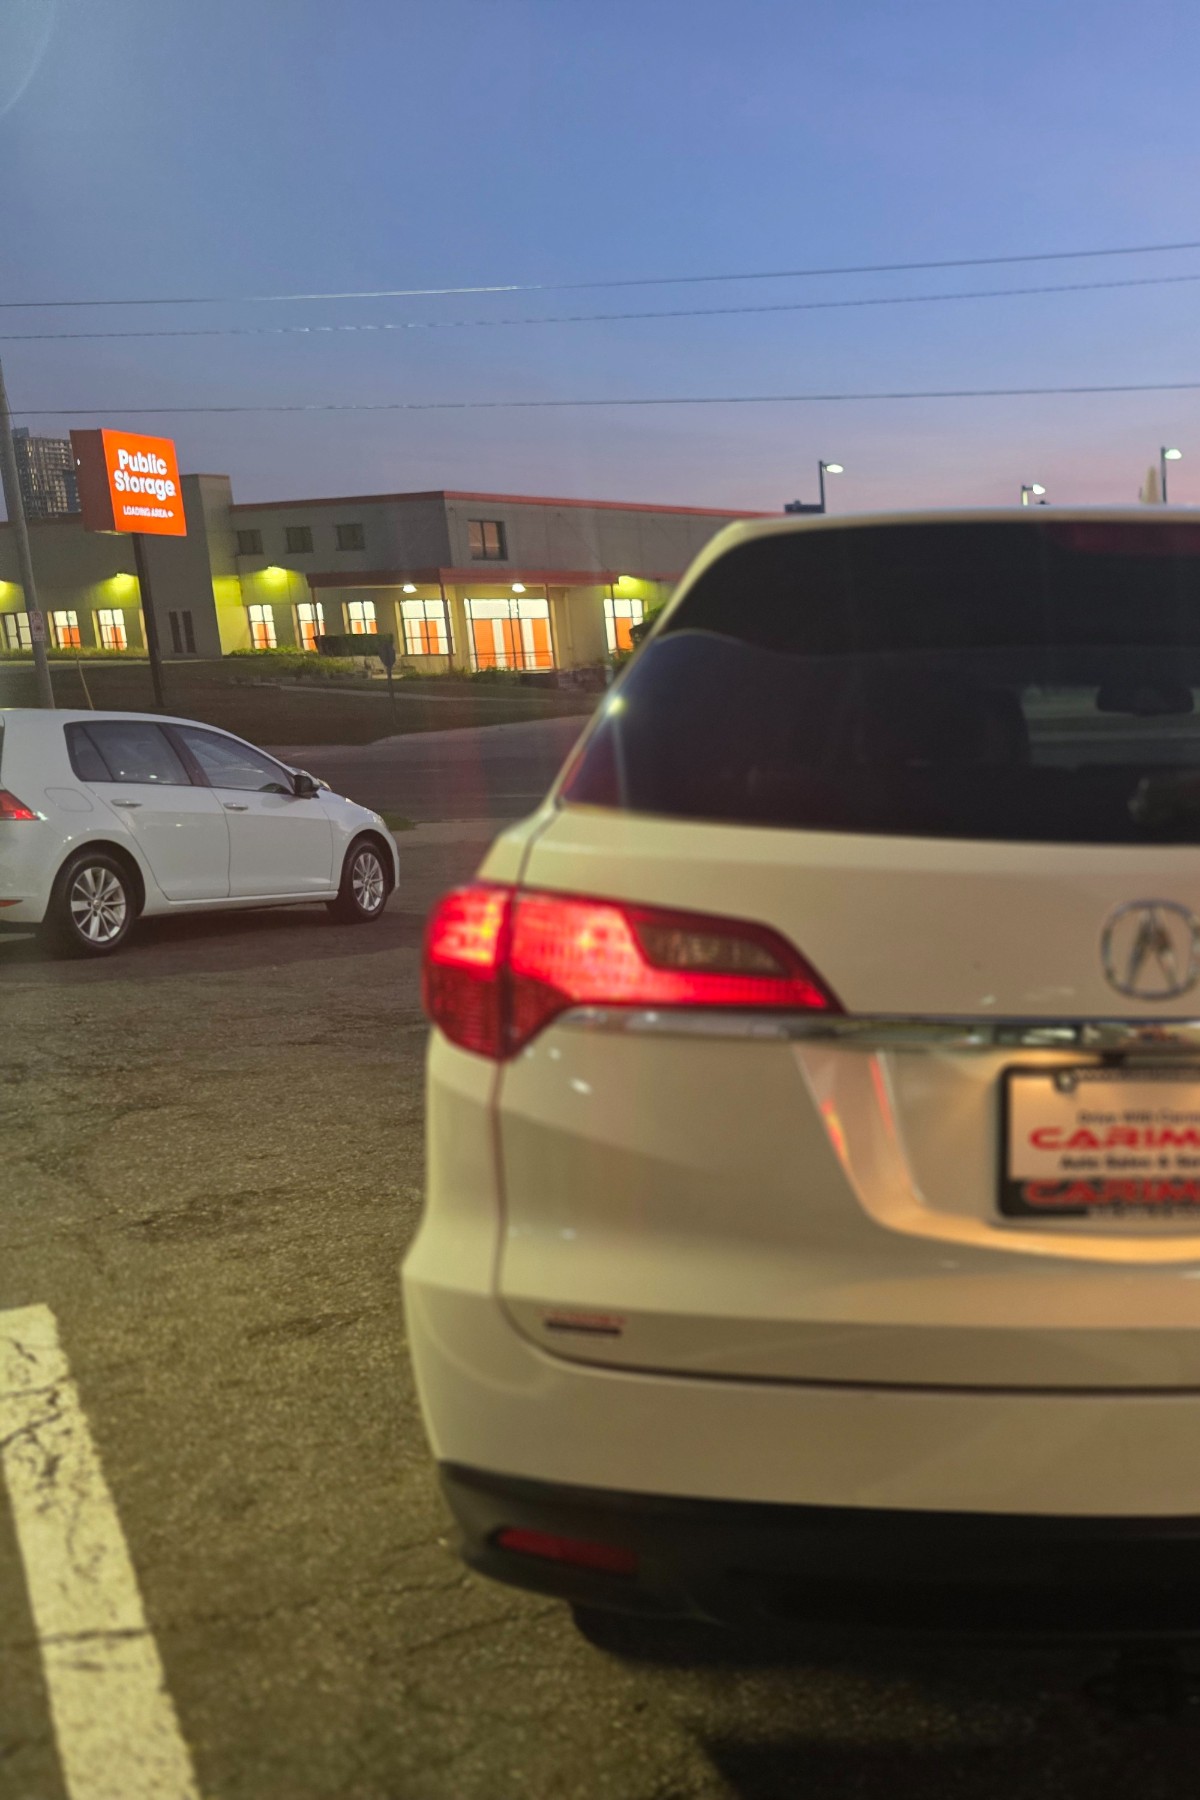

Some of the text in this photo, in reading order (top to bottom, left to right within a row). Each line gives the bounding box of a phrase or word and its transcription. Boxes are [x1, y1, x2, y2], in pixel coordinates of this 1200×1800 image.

[118, 449, 167, 475] Public
[114, 470, 176, 501] Storage
[1061, 1155, 1099, 1169] Auto
[1105, 1155, 1151, 1169] Sales
